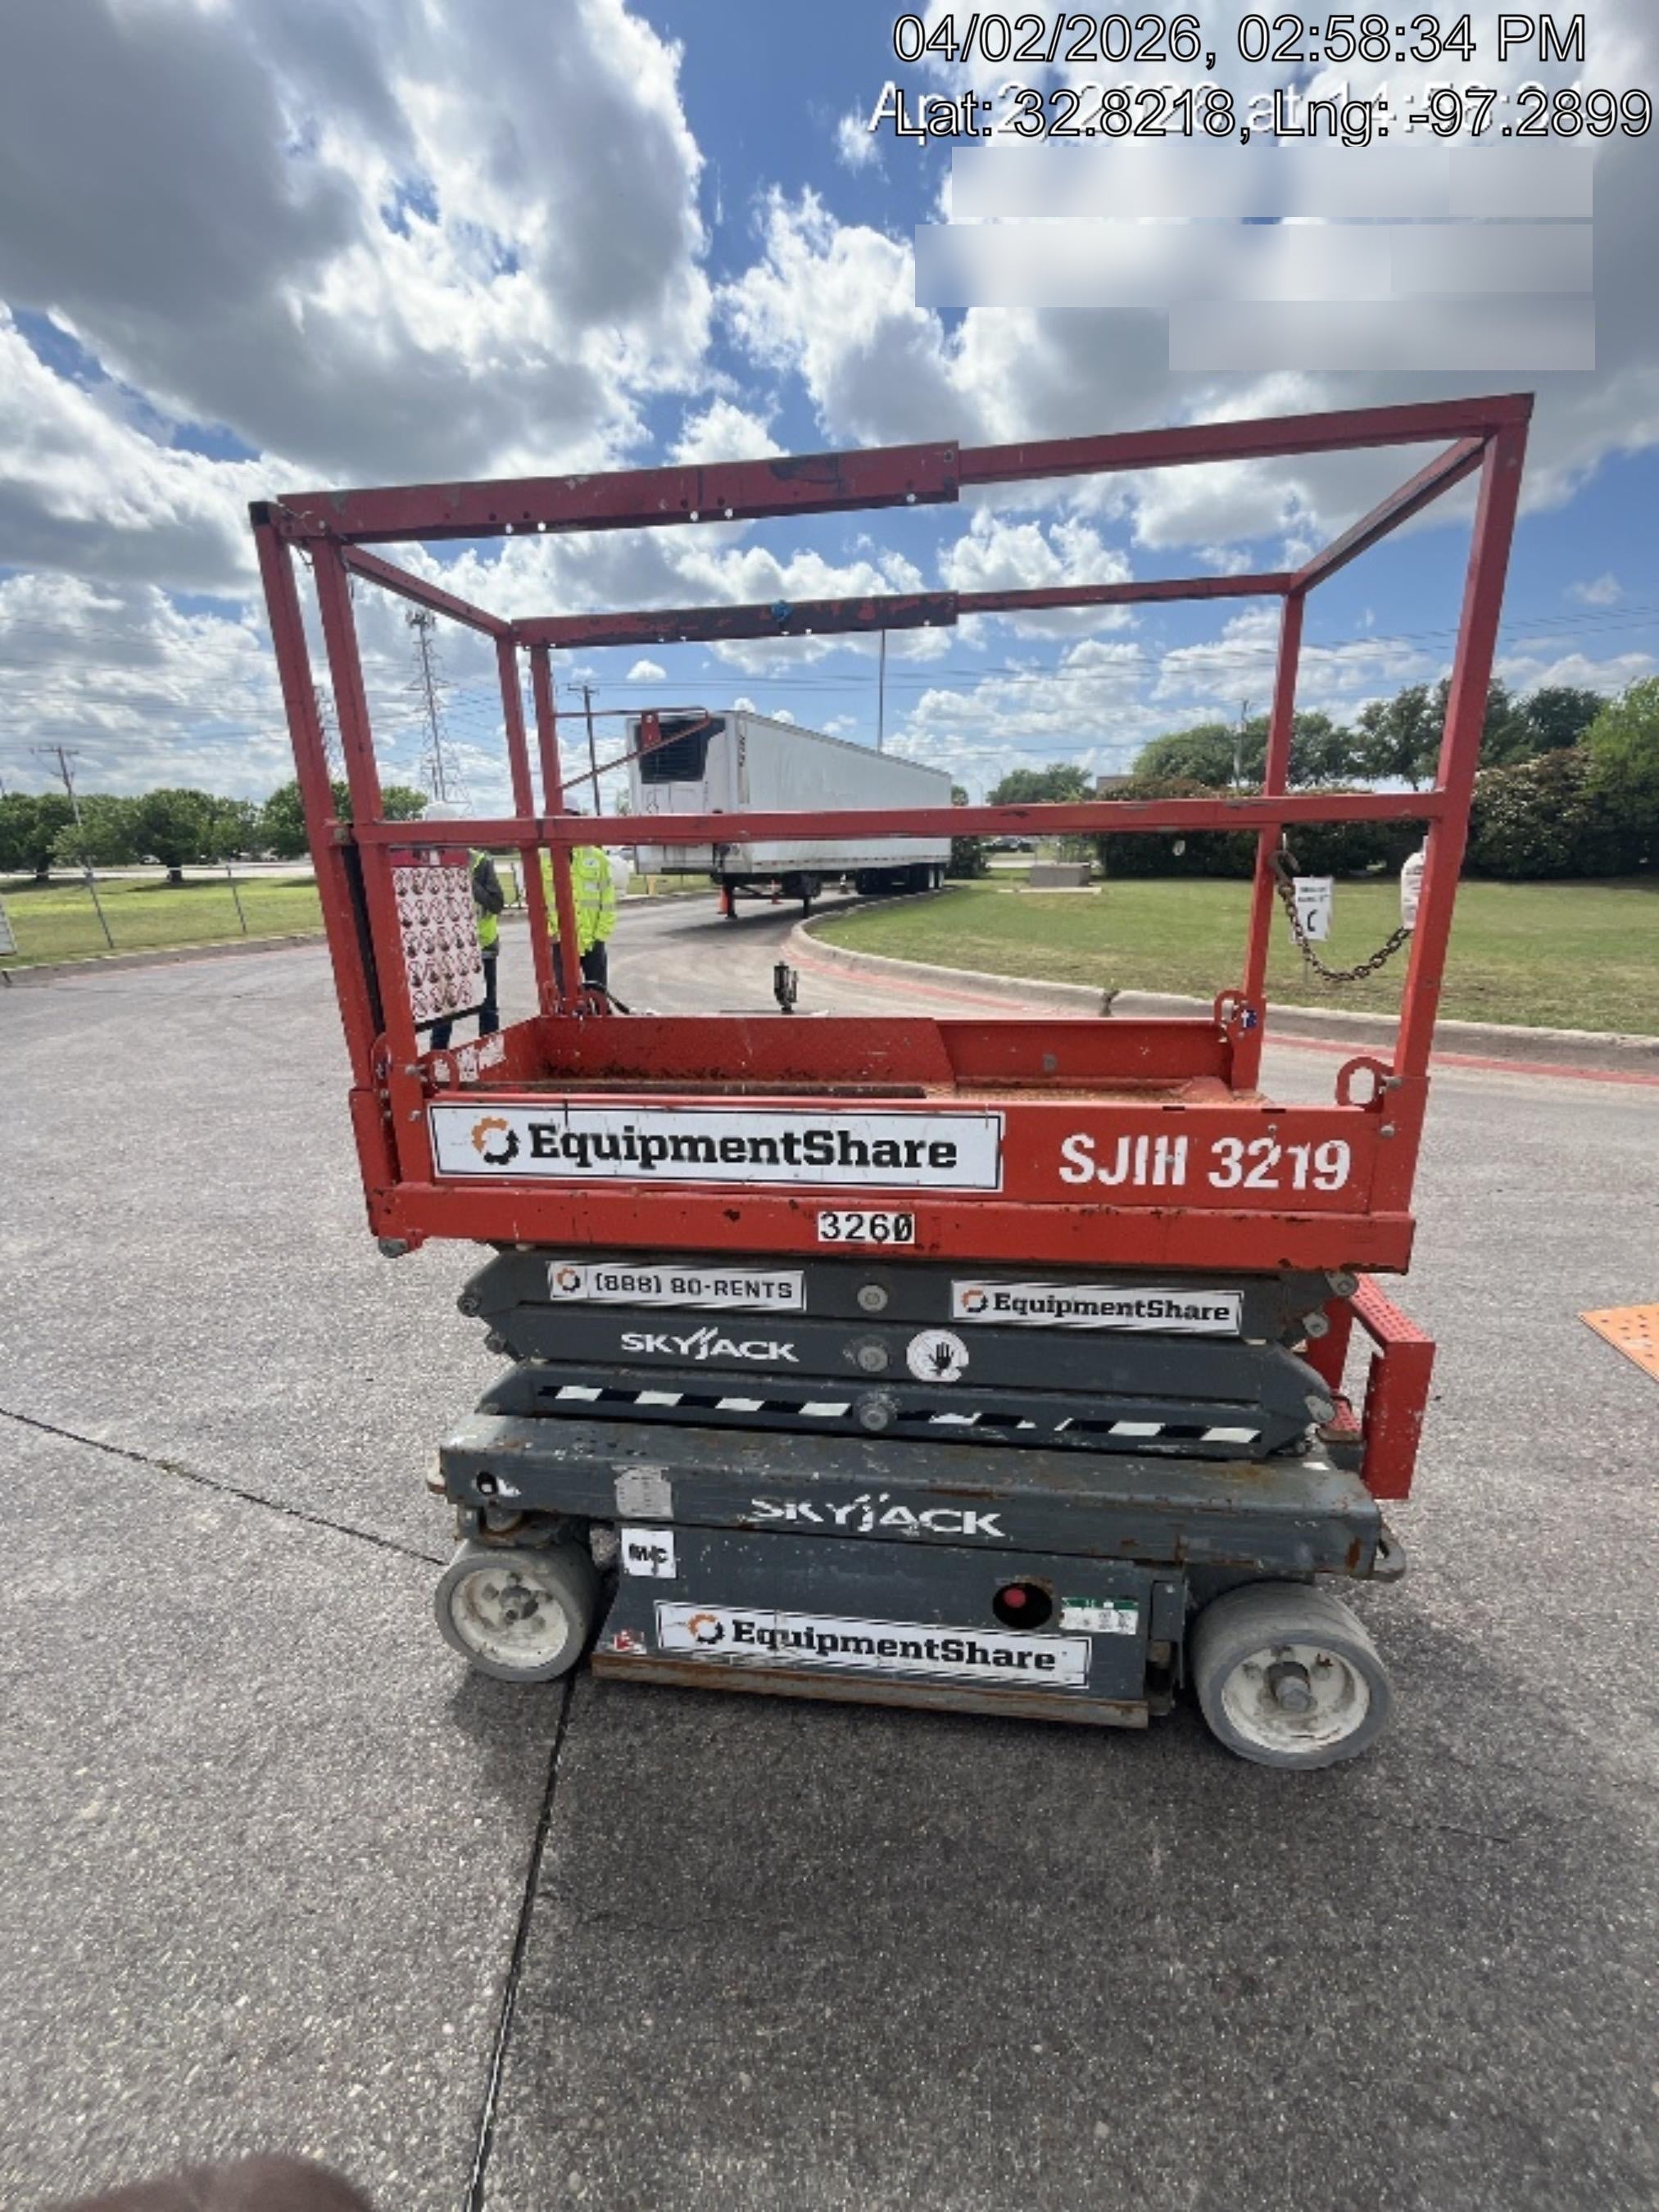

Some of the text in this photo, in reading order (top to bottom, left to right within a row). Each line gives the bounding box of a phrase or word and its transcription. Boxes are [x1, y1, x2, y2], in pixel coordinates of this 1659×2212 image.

[528, 1123, 957, 1169] EquipmentShare
[1208, 1138, 1352, 1191] 3219
[820, 1213, 913, 1242] 3260
[670, 1276, 793, 1299] 80-RENTS
[993, 1291, 1230, 1321] EquipmentShare
[620, 1327, 800, 1363] SKYJACK
[750, 1493, 1005, 1537] SKYJACK
[732, 1619, 1056, 1670] EquipmentShare
